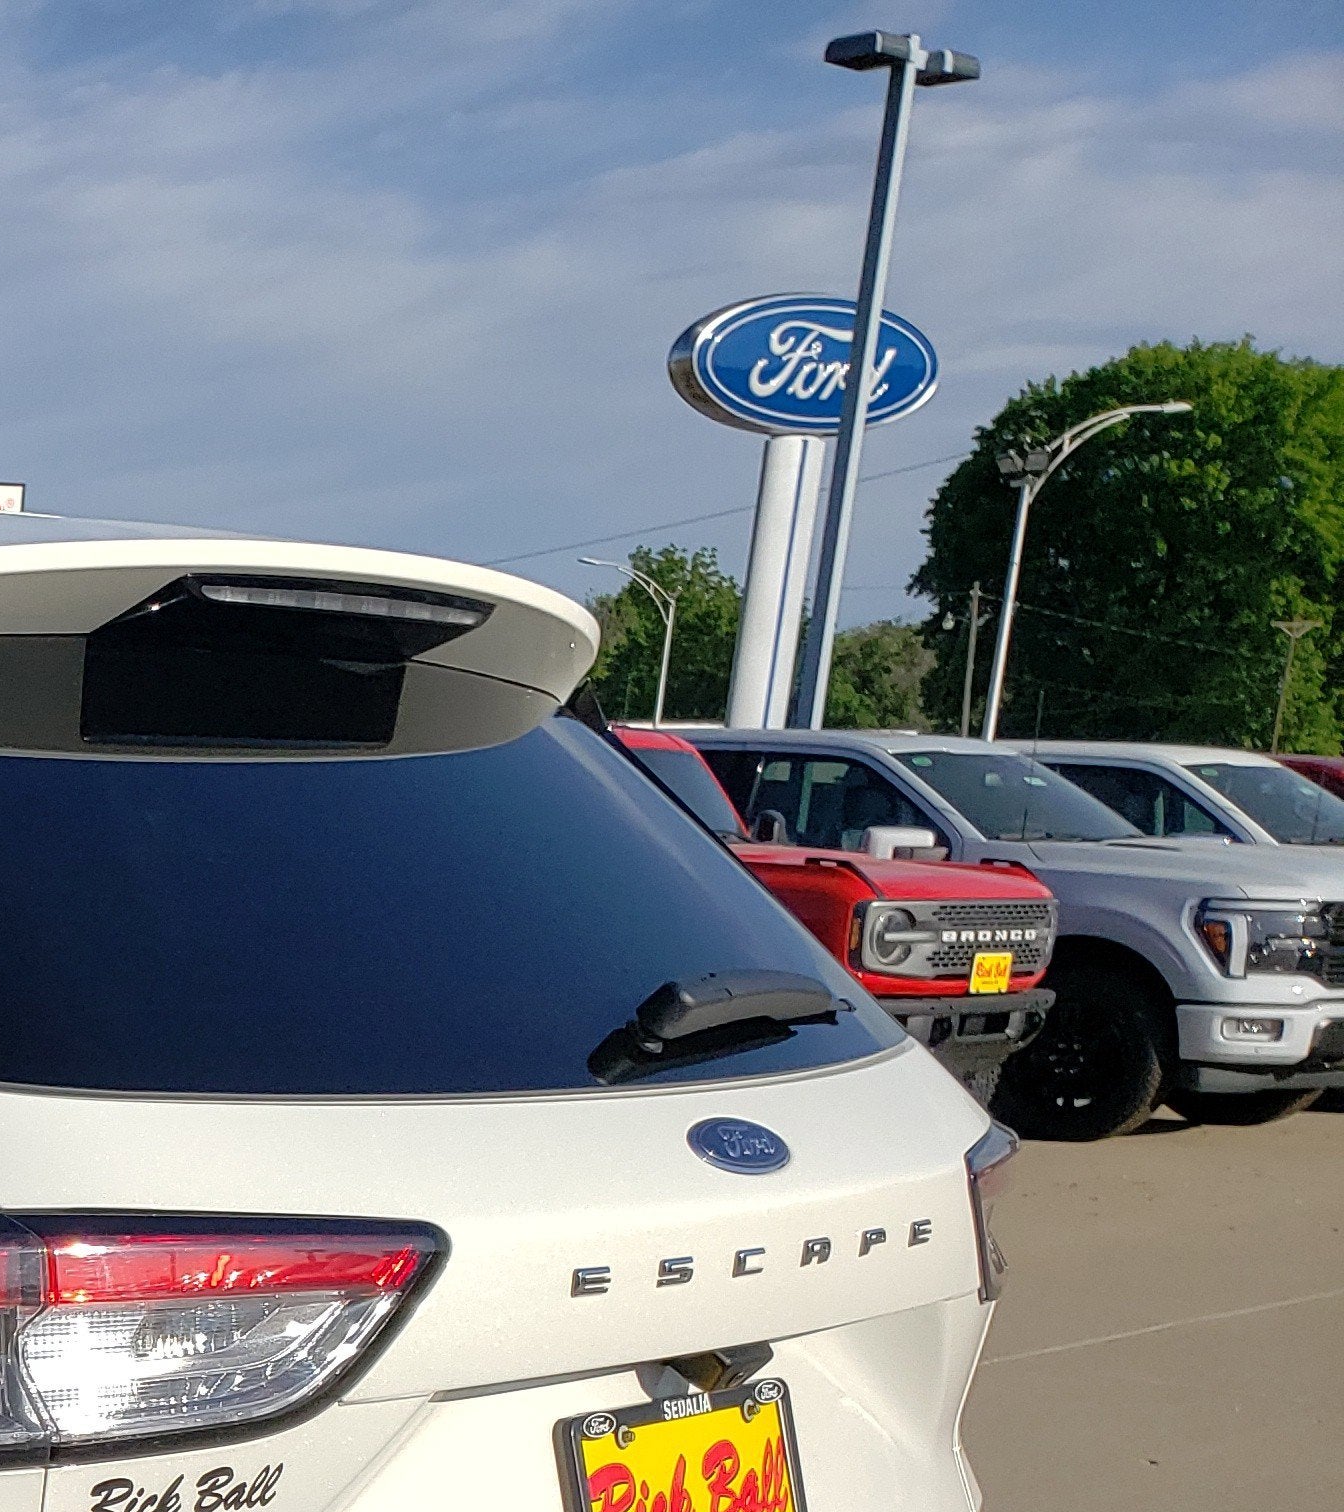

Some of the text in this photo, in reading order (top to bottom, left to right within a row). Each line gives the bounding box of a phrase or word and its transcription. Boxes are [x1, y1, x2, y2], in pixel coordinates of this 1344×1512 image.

[749, 320, 897, 403] Ford
[941, 928, 1038, 943] BRONCO
[716, 1125, 776, 1158] Ford
[570, 1218, 932, 1299] ESCAPE
[759, 1383, 780, 1400] Ford
[662, 1392, 713, 1421] SEDALIA
[589, 1417, 612, 1435] Ford
